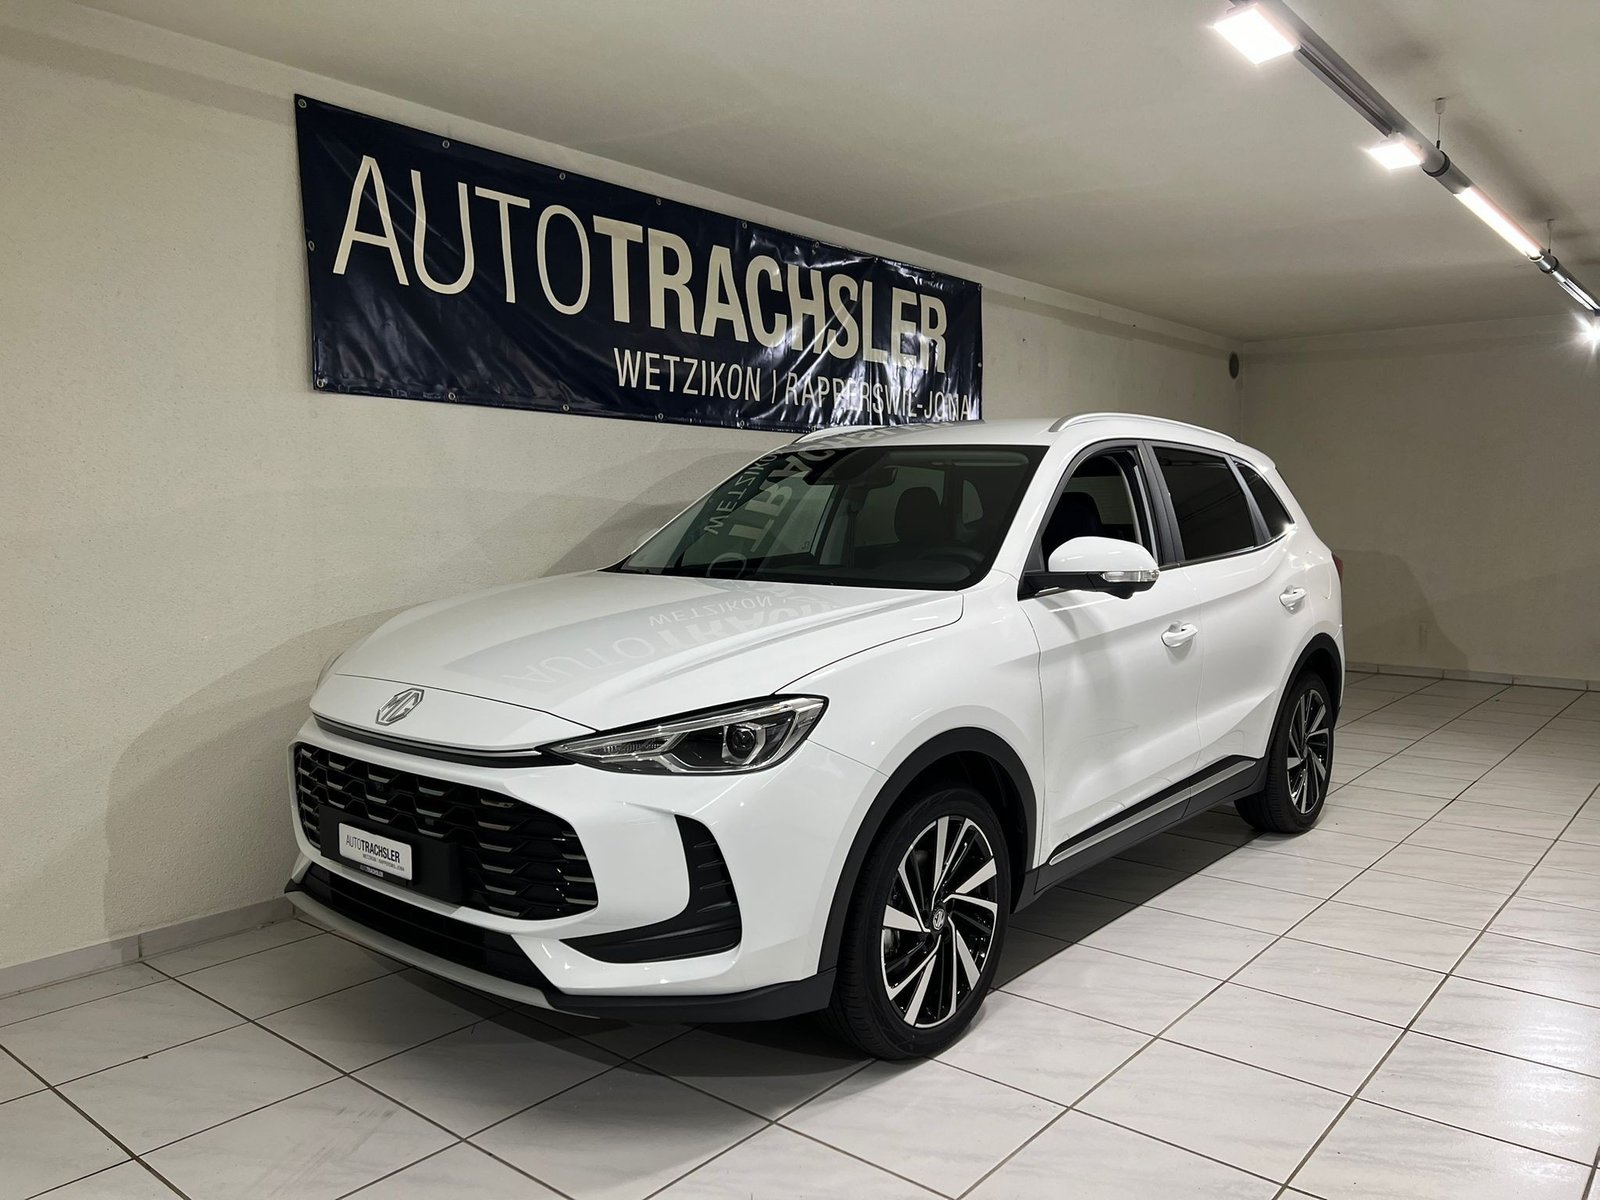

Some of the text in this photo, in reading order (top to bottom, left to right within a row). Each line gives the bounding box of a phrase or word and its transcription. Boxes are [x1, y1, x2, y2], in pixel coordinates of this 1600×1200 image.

[333, 154, 947, 373] AUTOTRACHSLER
[613, 347, 761, 402] WETZIKON
[346, 834, 400, 863] AUTOTRACHSLER
